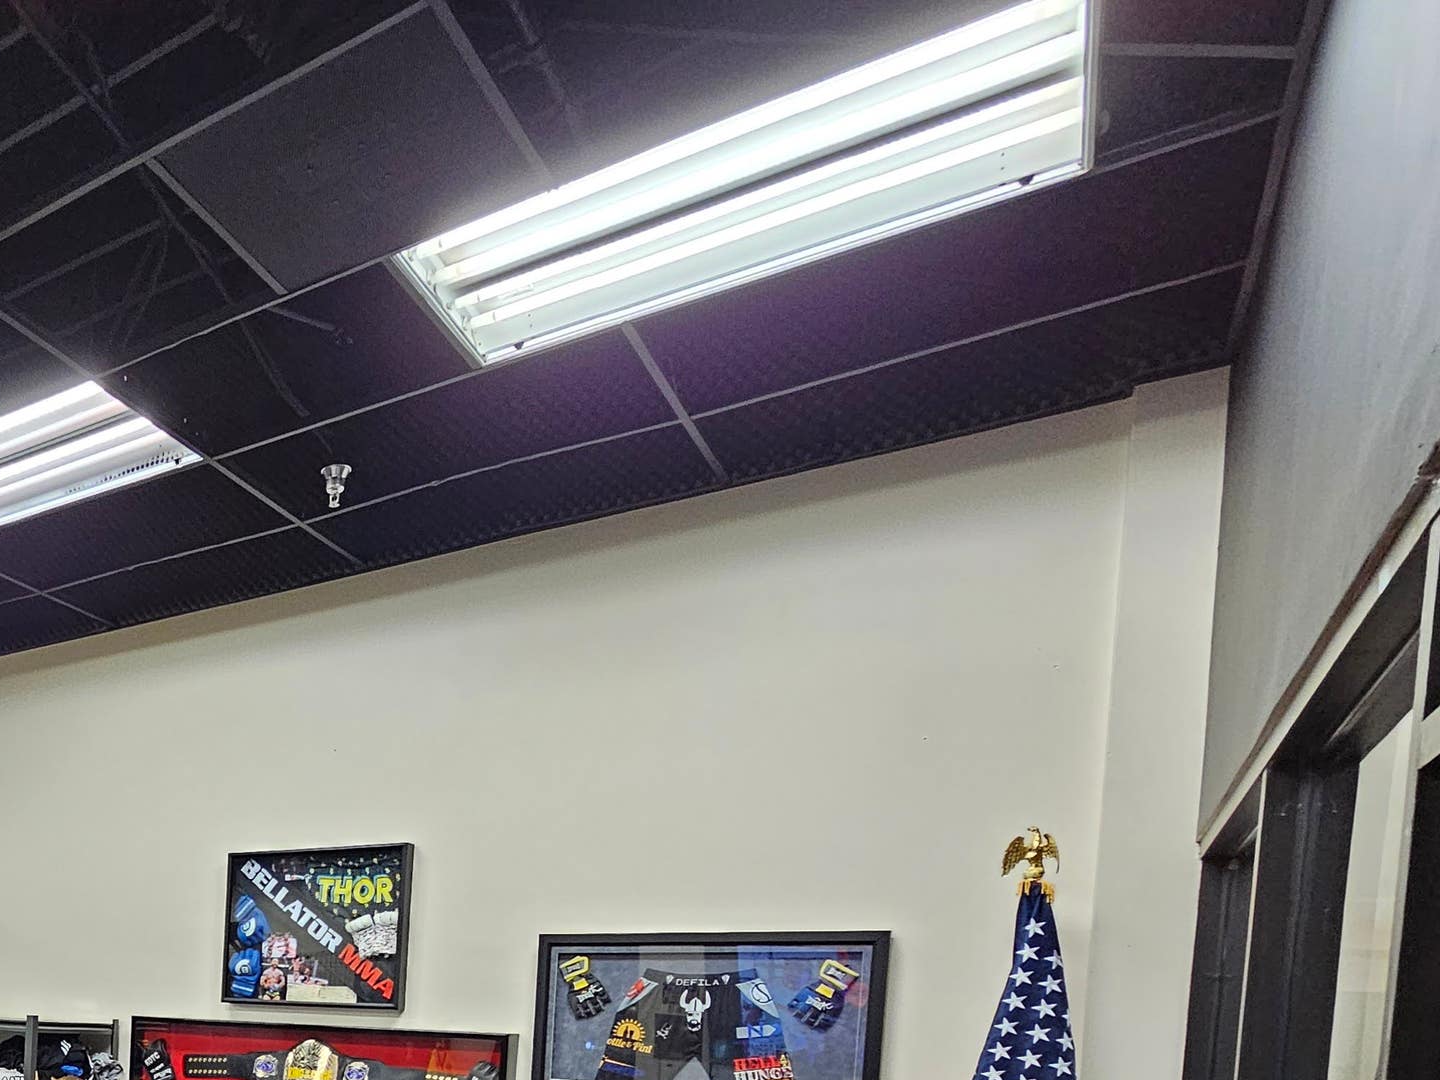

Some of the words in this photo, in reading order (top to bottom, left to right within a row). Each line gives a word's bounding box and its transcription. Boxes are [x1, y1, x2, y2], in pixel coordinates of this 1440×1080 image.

[240, 858, 344, 953] BELLATOR
[317, 874, 393, 904] THOR
[338, 943, 395, 1000] MMA
[675, 978, 720, 987] DEFILA
